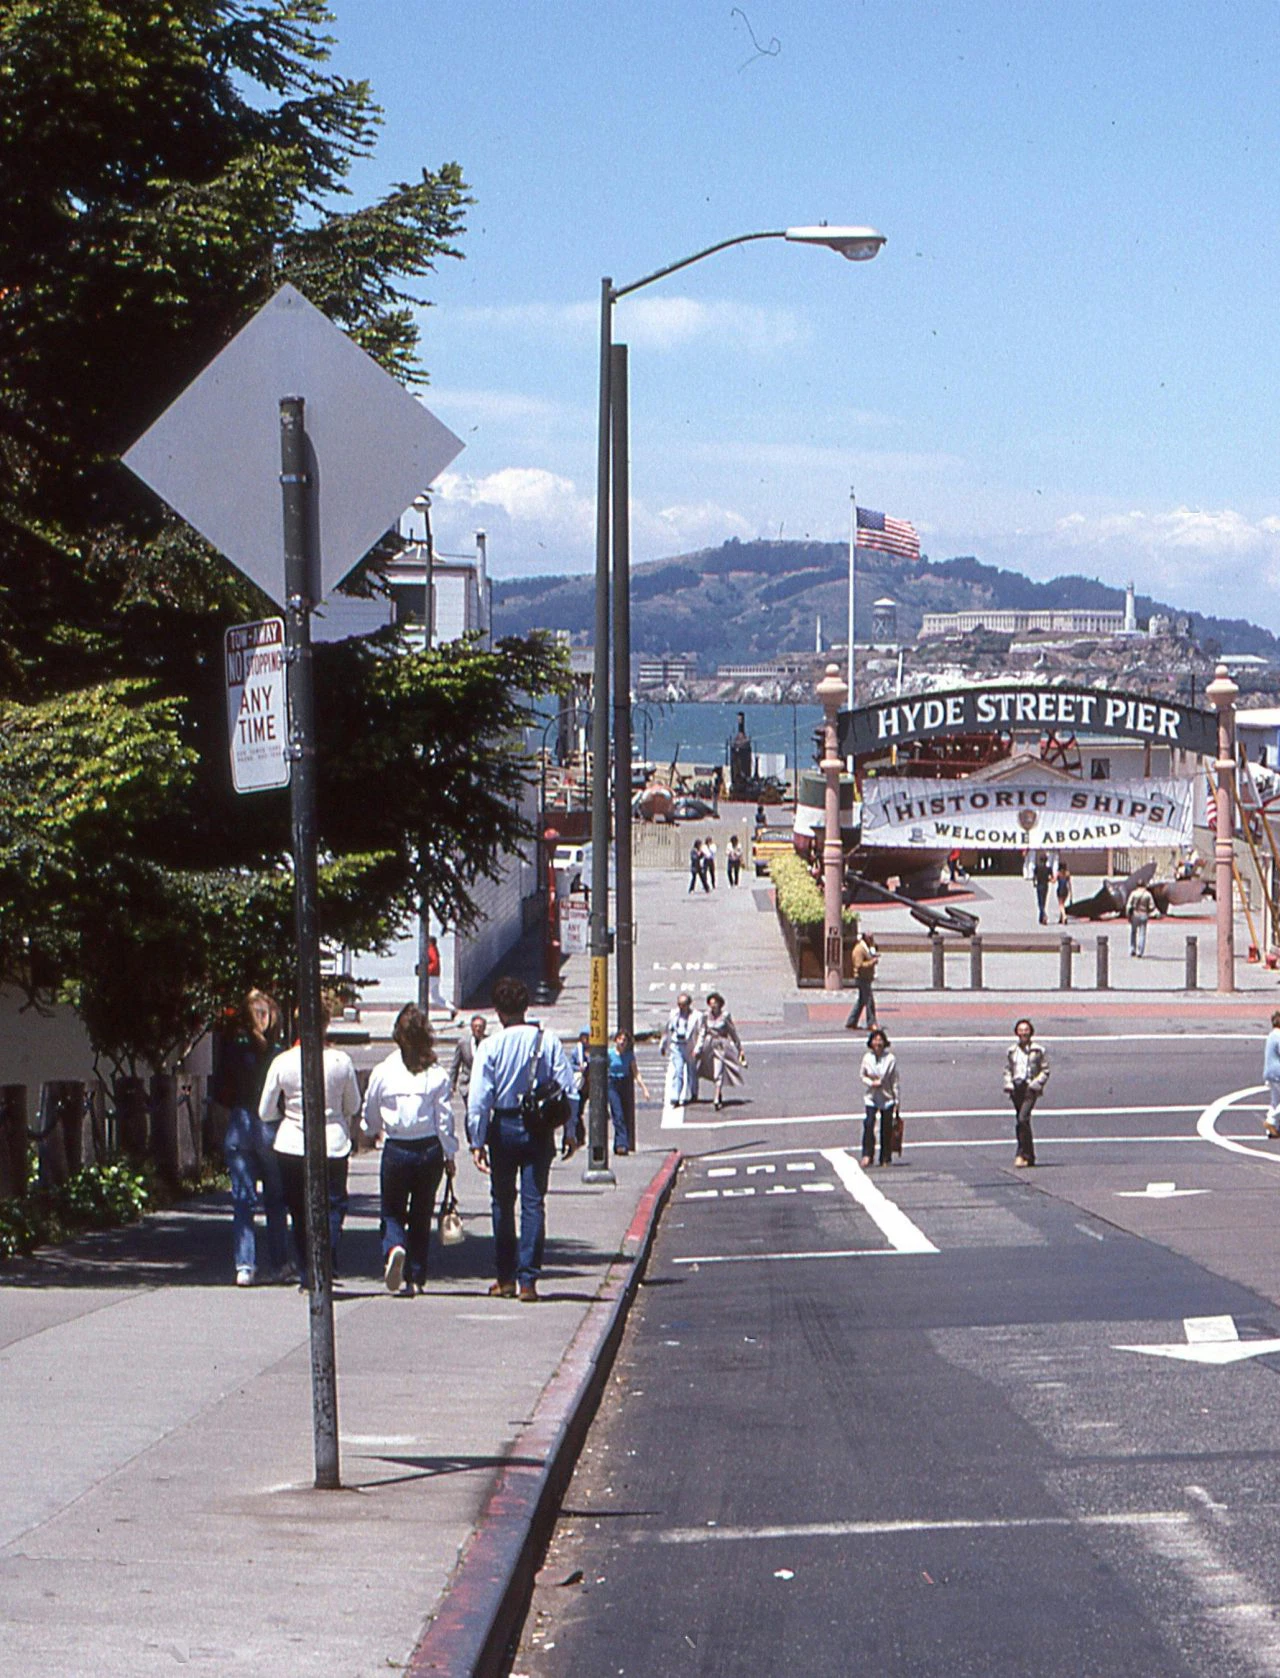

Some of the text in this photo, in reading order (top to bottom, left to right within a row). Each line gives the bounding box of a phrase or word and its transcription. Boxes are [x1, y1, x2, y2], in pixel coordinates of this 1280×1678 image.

[228, 652, 242, 682] NO
[240, 685, 272, 715] ANY
[239, 715, 276, 744] TIME
[877, 692, 1182, 740] HYDE STREET PIER
[896, 788, 1166, 824] HISTORIC SHIPS
[935, 821, 1122, 845] WELCOME ABOARD
[653, 962, 717, 971] LANE
[648, 981, 716, 992] FIRE
